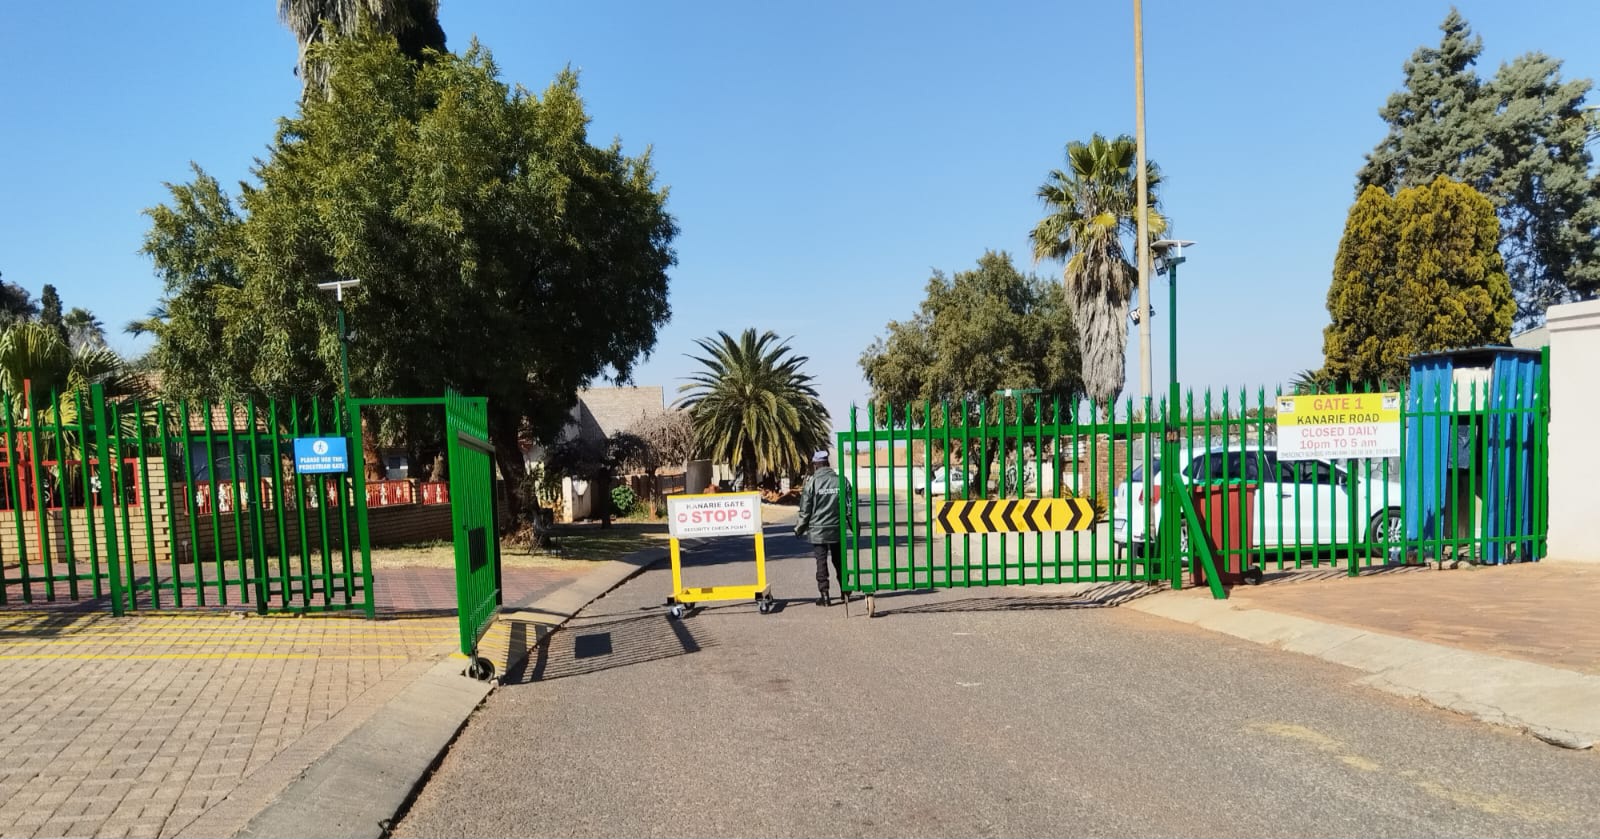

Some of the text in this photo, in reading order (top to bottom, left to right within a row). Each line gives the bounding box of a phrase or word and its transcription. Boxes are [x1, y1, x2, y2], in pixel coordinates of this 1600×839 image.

[1313, 397, 1364, 411] GATE 1
[1297, 413, 1380, 425] KANARIE ROAD
[1301, 426, 1378, 438] CLOSED DAILY
[1300, 440, 1330, 451] 10pm
[1334, 439, 1347, 448] TO
[1351, 438, 1358, 447] 5
[686, 501, 722, 509] KANARIE
[691, 509, 738, 523] STOP
